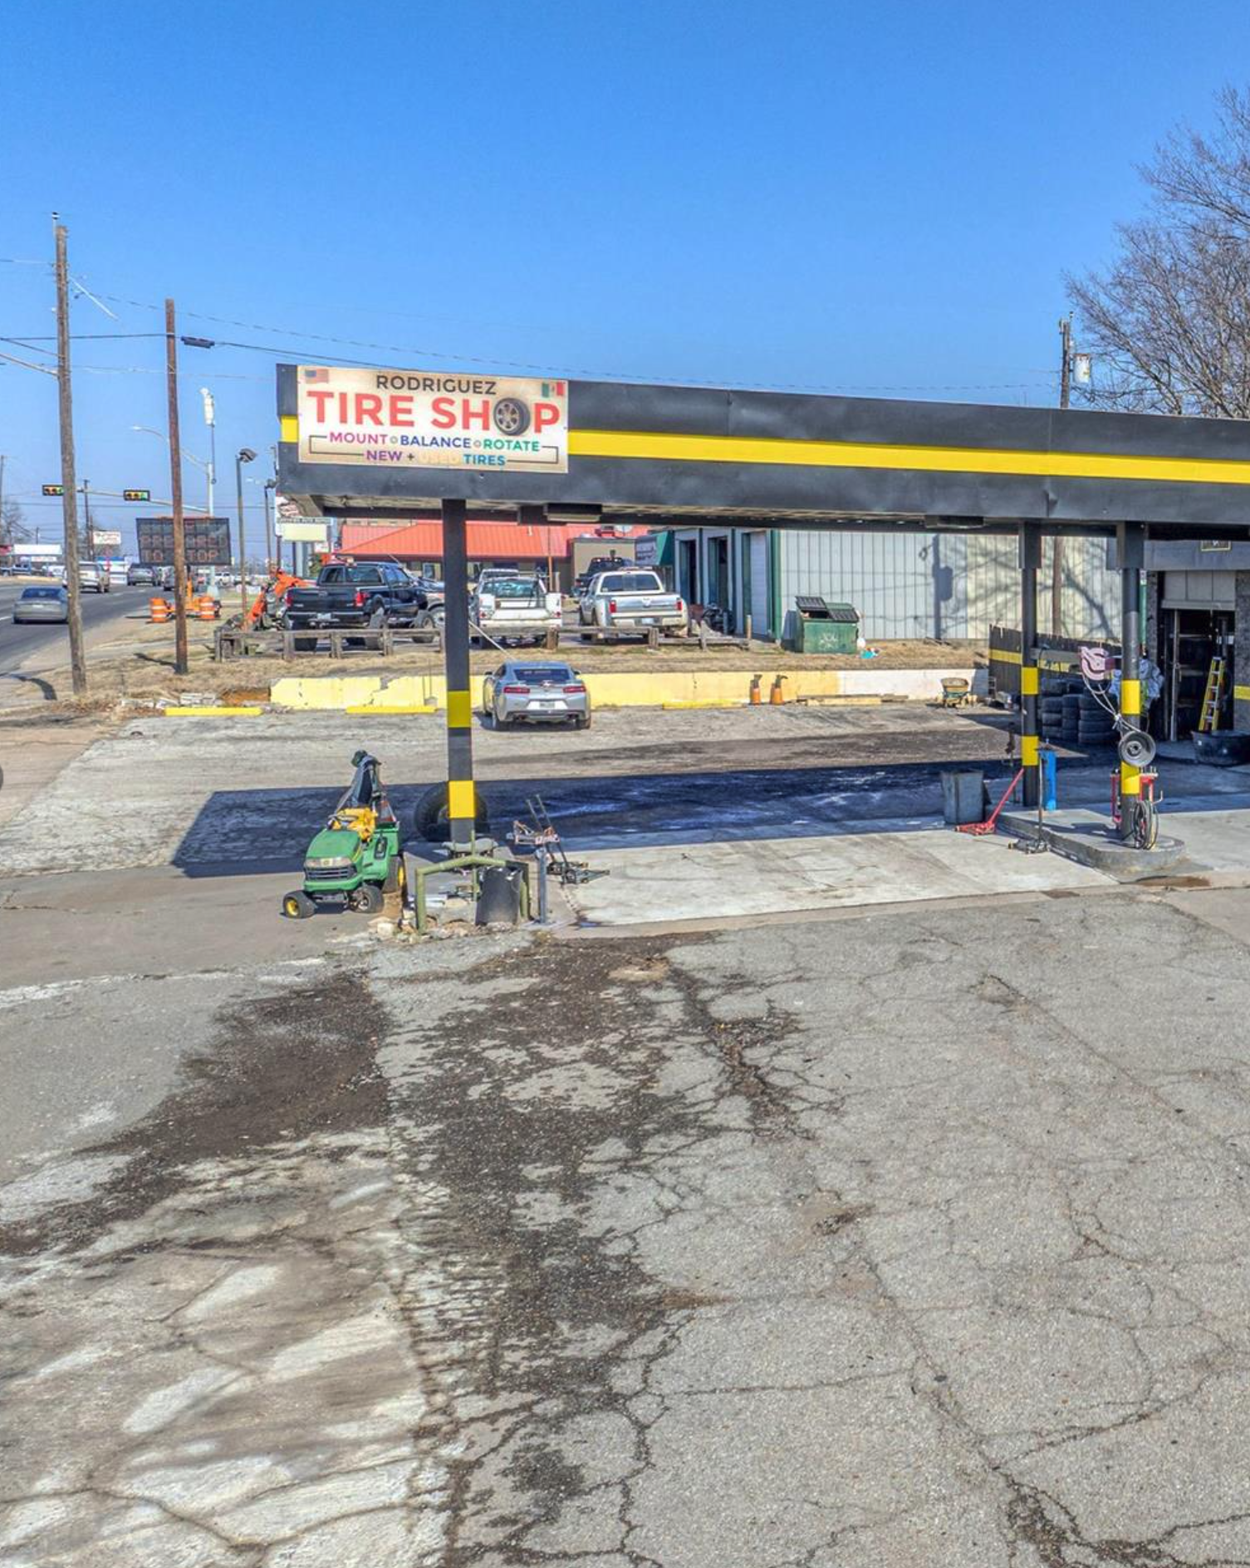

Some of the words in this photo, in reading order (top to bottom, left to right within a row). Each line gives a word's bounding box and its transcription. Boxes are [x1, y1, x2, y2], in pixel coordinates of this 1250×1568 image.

[376, 375, 497, 395] RODRIGUEZ
[306, 390, 415, 427] TIRE
[329, 432, 388, 445] MOUNT
[400, 435, 472, 449] BALANCE
[483, 439, 540, 452] ROTATE
[366, 450, 403, 461] NEW
[463, 454, 506, 466] TIRES
[140, 535, 228, 549] PREARED
